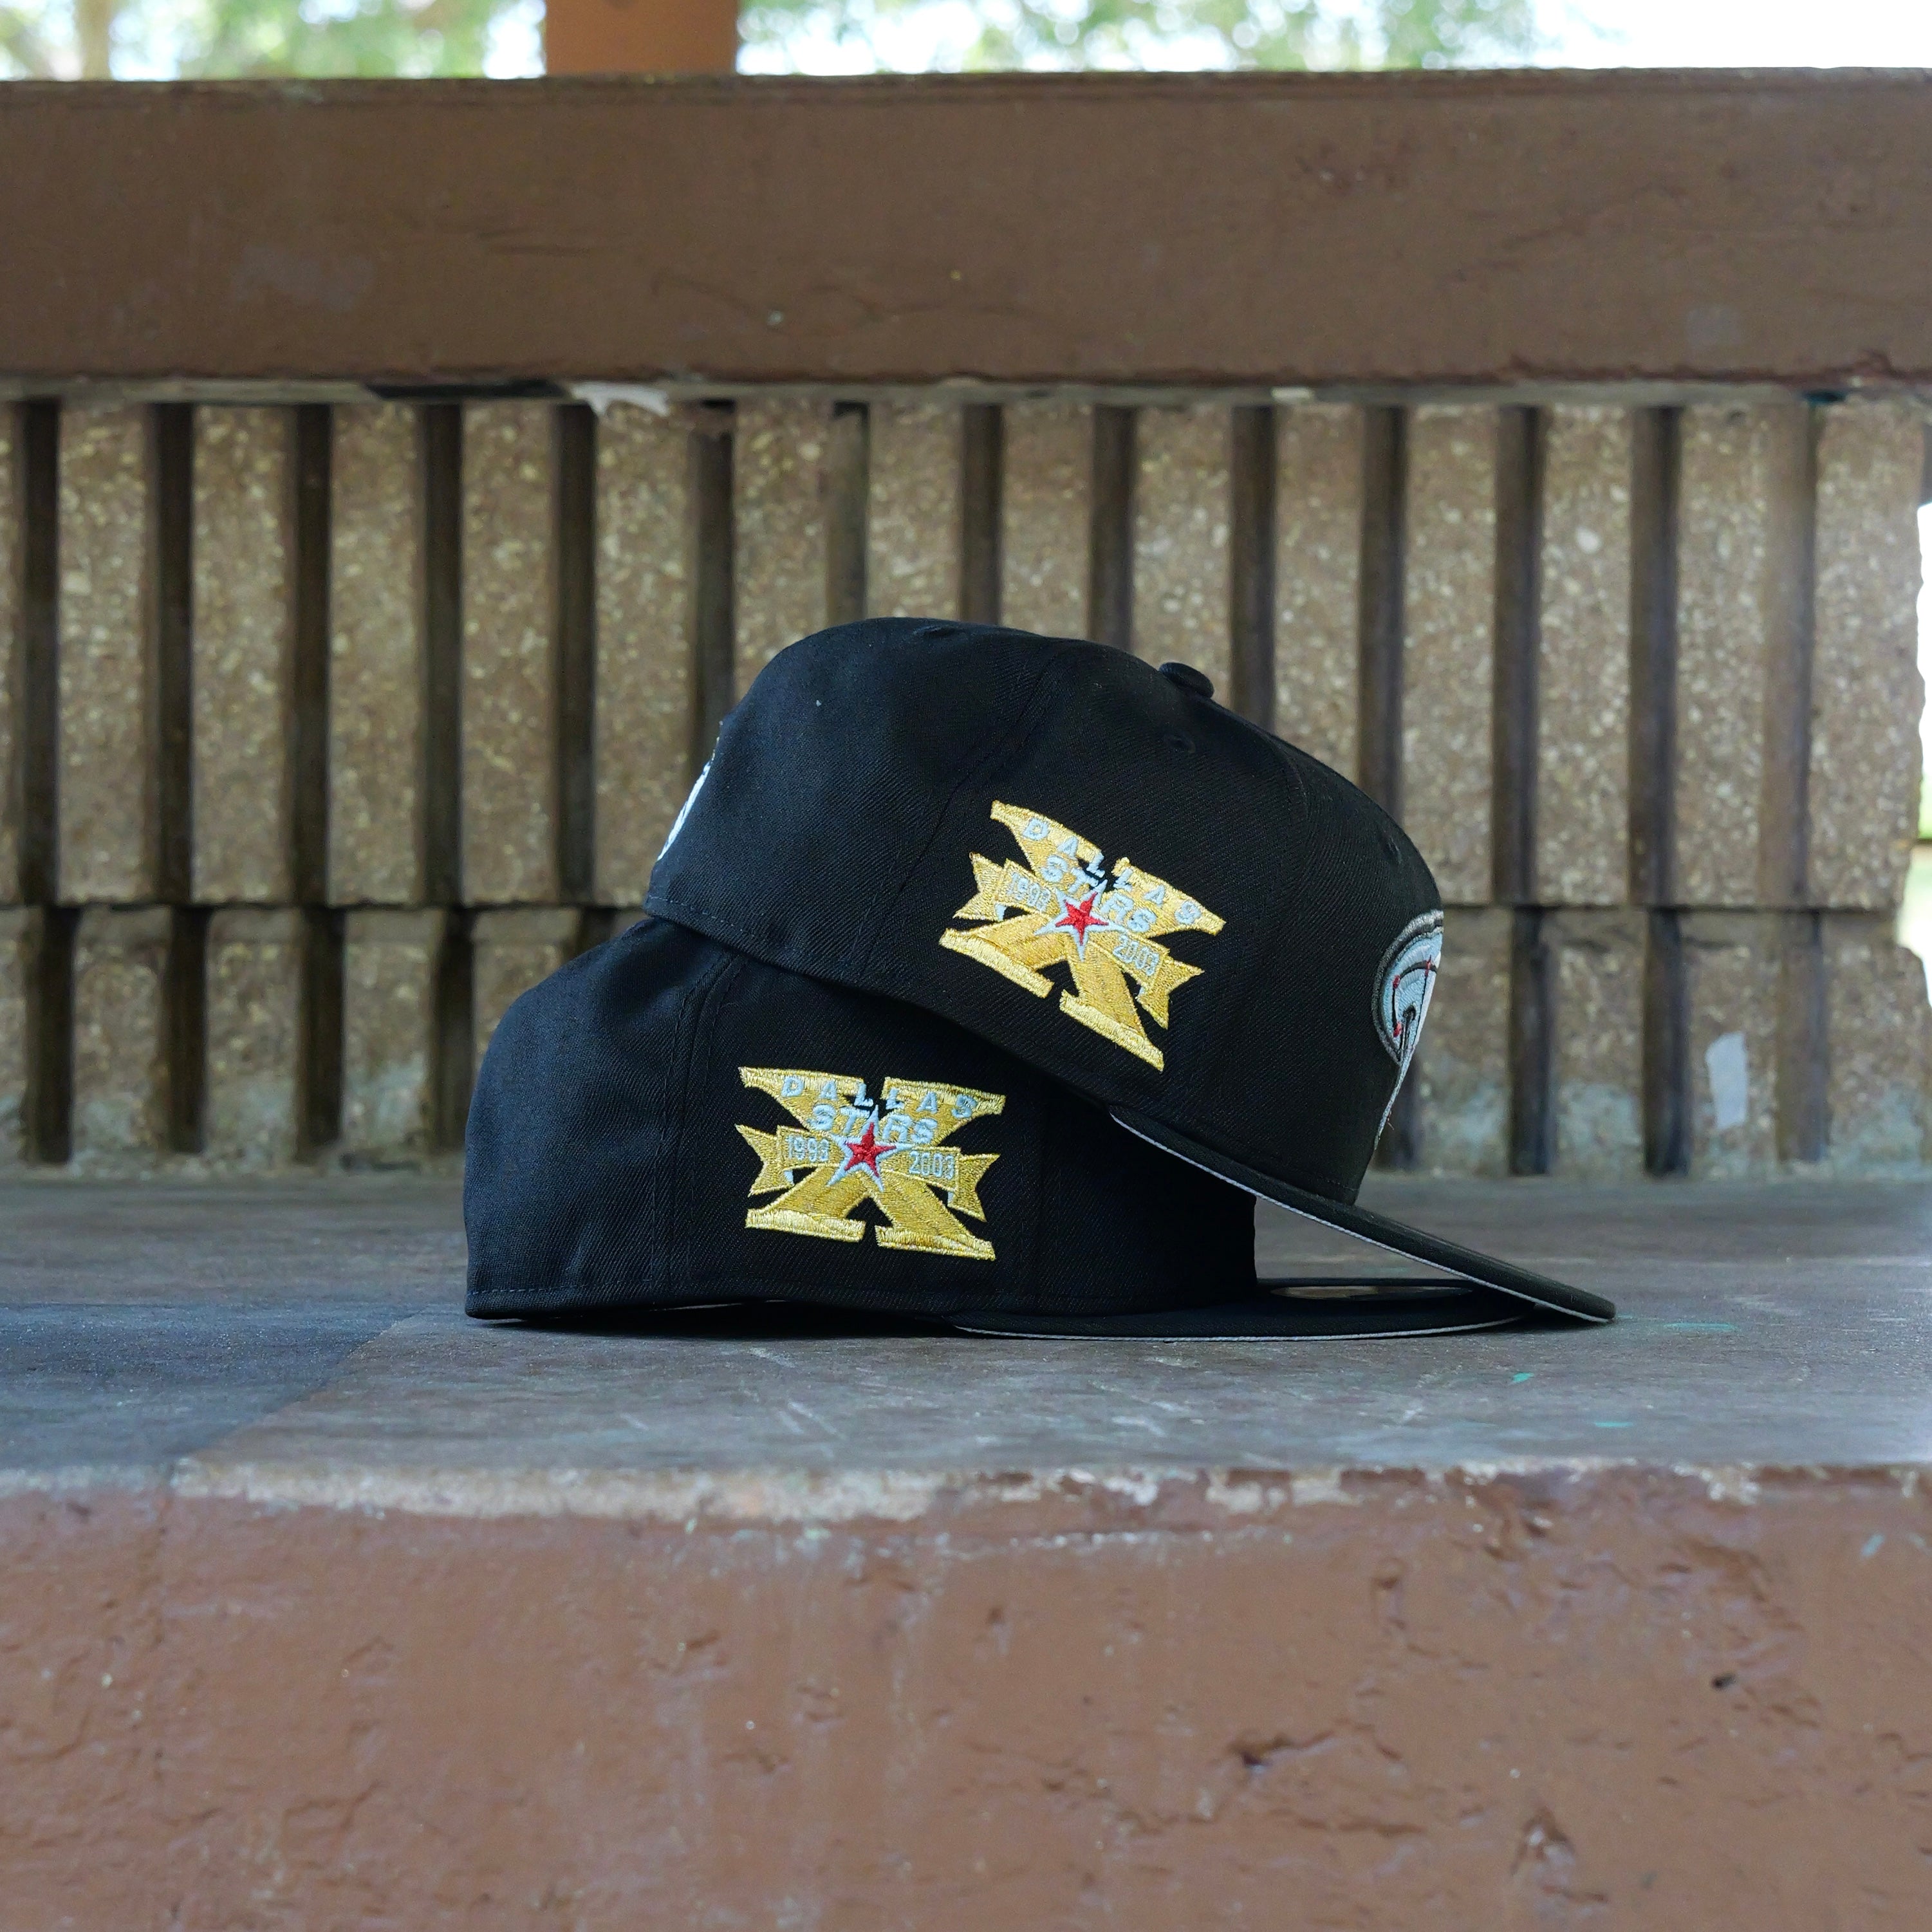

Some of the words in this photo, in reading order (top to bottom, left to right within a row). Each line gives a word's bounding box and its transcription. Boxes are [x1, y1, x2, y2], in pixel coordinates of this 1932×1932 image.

[1022, 818, 1202, 925] DALLAS
[1112, 934, 1160, 976] 2003
[781, 1075, 978, 1119] DALLAS
[785, 1135, 830, 1162] 1993
[909, 1150, 955, 1180] 2003
